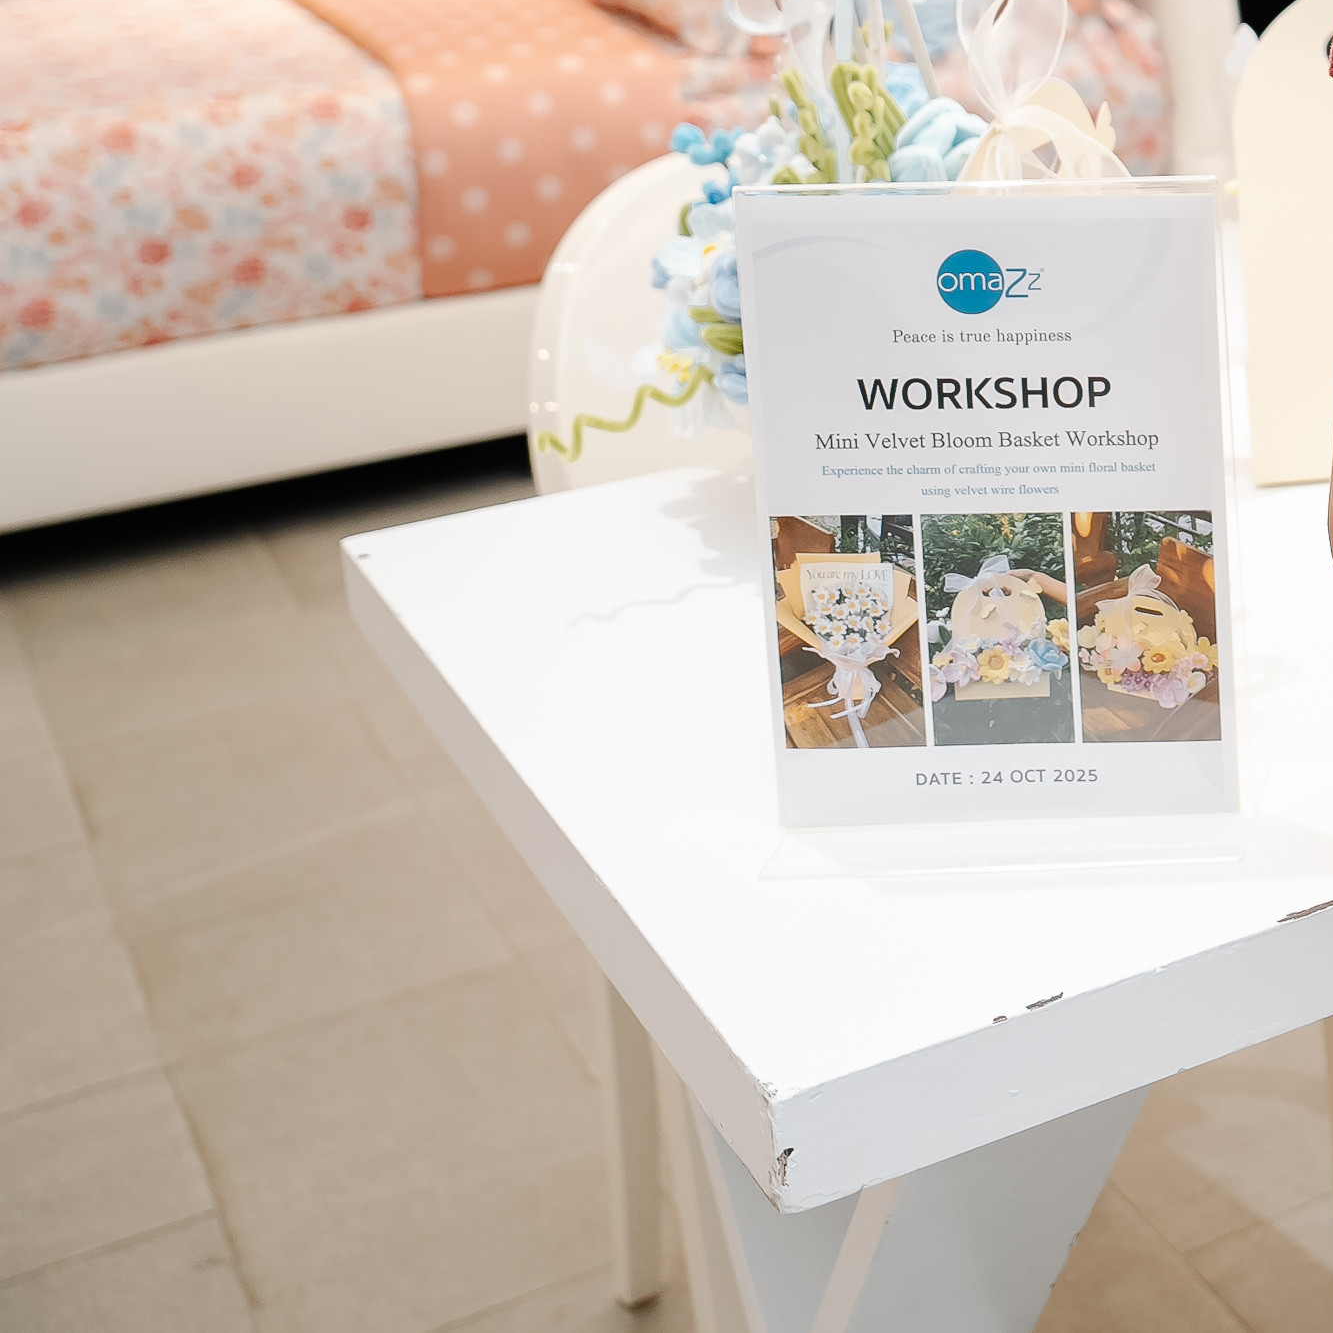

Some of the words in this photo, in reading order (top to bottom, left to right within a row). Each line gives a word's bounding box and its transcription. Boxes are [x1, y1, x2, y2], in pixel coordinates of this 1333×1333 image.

[892, 329, 937, 344] Peace
[942, 330, 955, 343] is
[960, 330, 991, 343] true
[996, 328, 1072, 346] happiness
[857, 376, 1111, 411] WORKSHOP
[814, 432, 860, 450] Mini
[865, 432, 926, 449] Velvet
[931, 431, 993, 449] Bloom
[998, 430, 1060, 448] Basket
[1065, 429, 1160, 450] Workshop
[821, 465, 883, 478] Experience
[886, 464, 903, 475] the
[906, 464, 941, 476] charm
[944, 463, 956, 475] of
[958, 463, 1001, 477] crafting
[1004, 465, 1030, 477] your
[1033, 465, 1057, 474] own
[1059, 462, 1085, 474] mini
[1088, 461, 1118, 473] floral
[1120, 461, 1156, 473] basket
[921, 485, 951, 499] using
[954, 485, 988, 496] velvet
[990, 484, 1015, 495] wire
[1018, 484, 1060, 495] flowers
[915, 771, 963, 786] DATE
[981, 770, 1004, 785] 24
[1010, 769, 1047, 783] OCT
[1053, 769, 1098, 783] 2025
